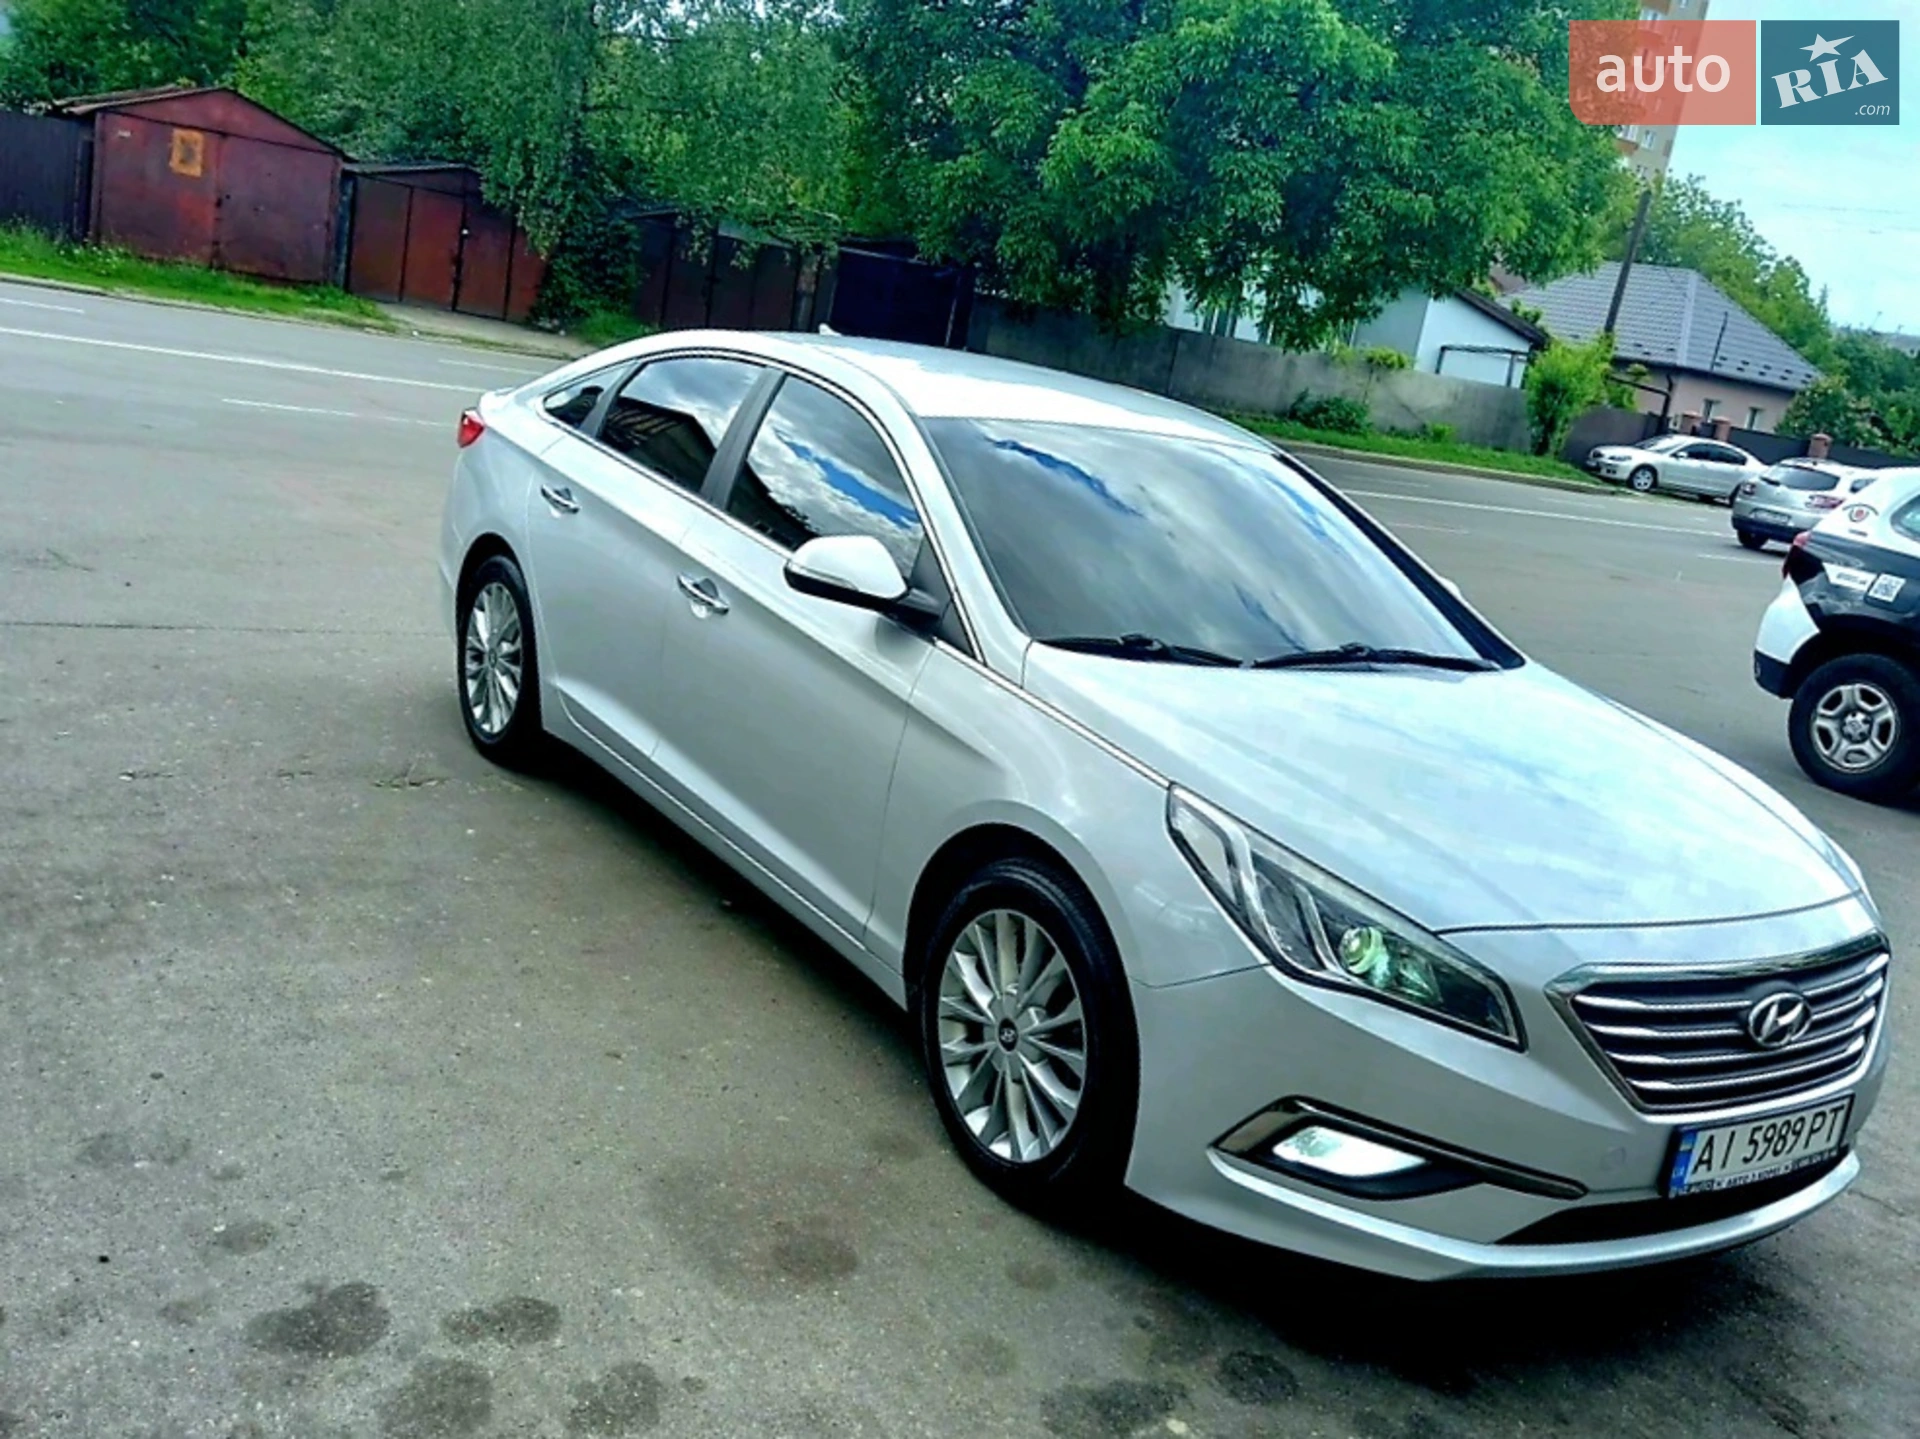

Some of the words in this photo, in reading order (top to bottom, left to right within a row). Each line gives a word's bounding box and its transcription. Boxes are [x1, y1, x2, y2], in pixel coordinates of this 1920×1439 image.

[1692, 1130, 1736, 1175] AI
[1742, 1117, 1806, 1165] 5989
[1803, 1104, 1845, 1149] PT
